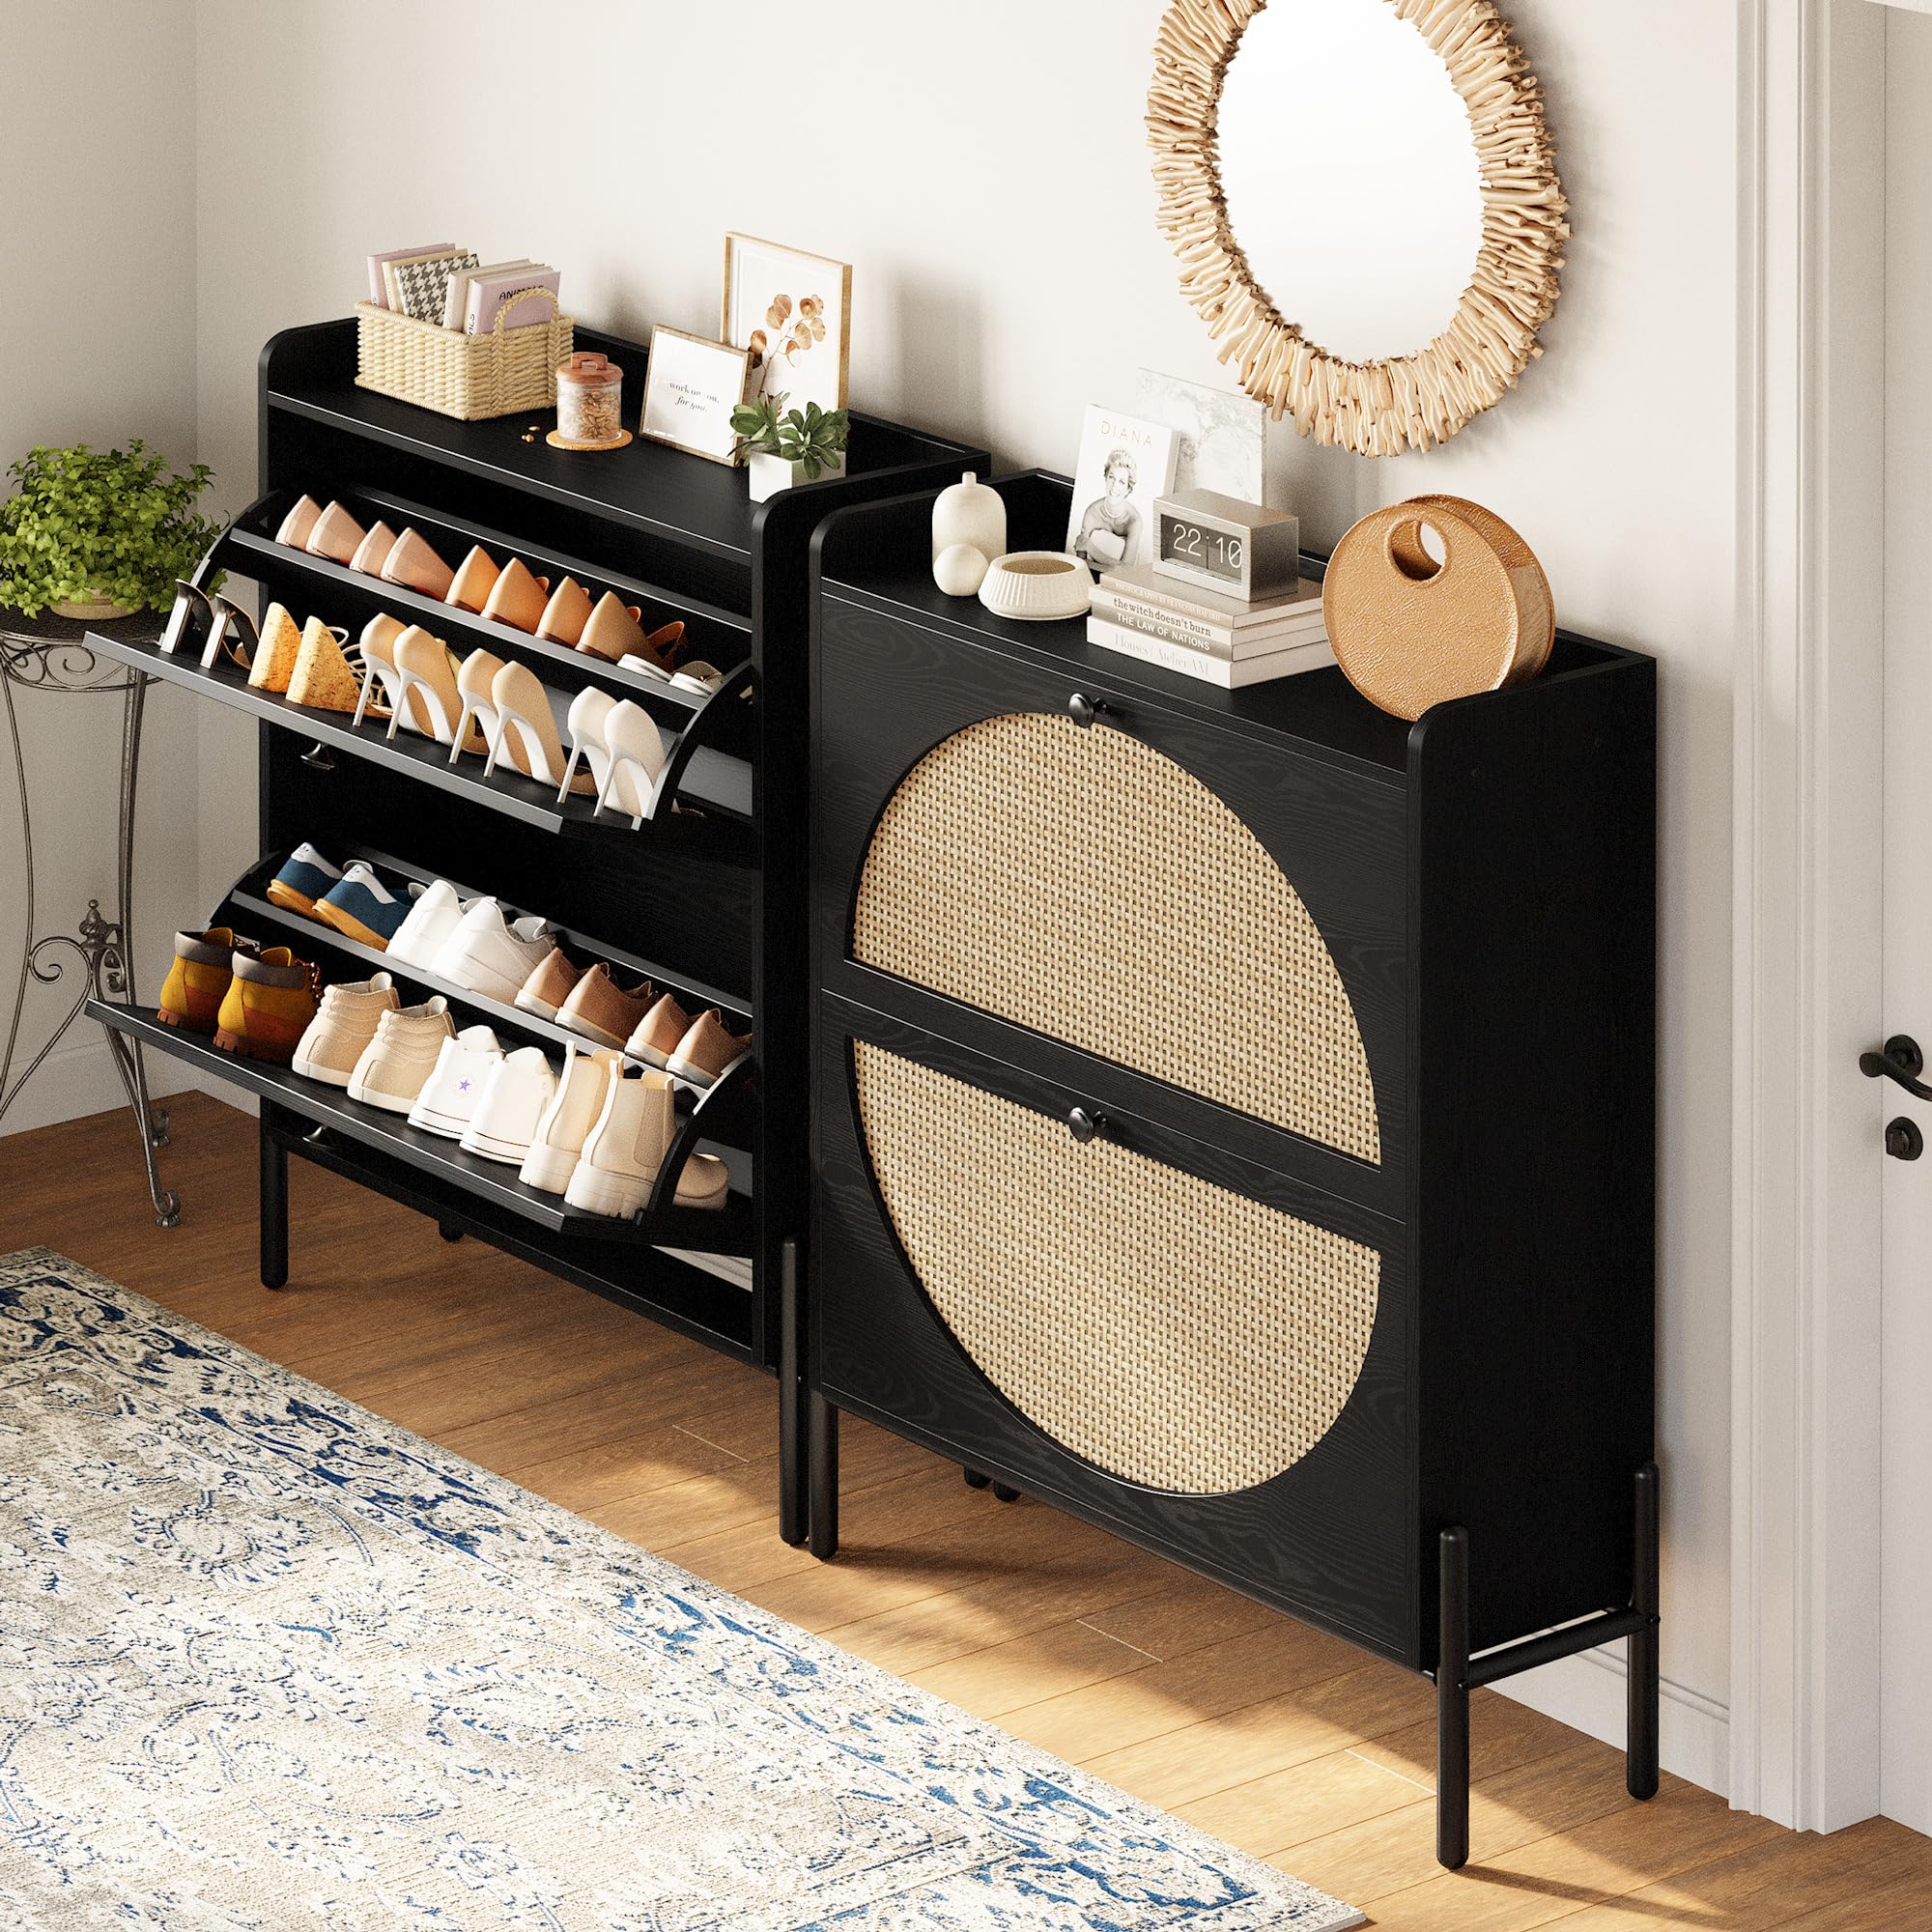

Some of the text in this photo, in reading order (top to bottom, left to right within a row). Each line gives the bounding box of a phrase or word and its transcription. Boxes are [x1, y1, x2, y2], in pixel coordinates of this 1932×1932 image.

[669, 383, 689, 394] work
[675, 395, 690, 406] for
[1101, 420, 1152, 448] DIANA
[1114, 598, 1211, 637] the witch doesn't burn
[1117, 612, 1210, 651] THE LAW OF NATIONS
